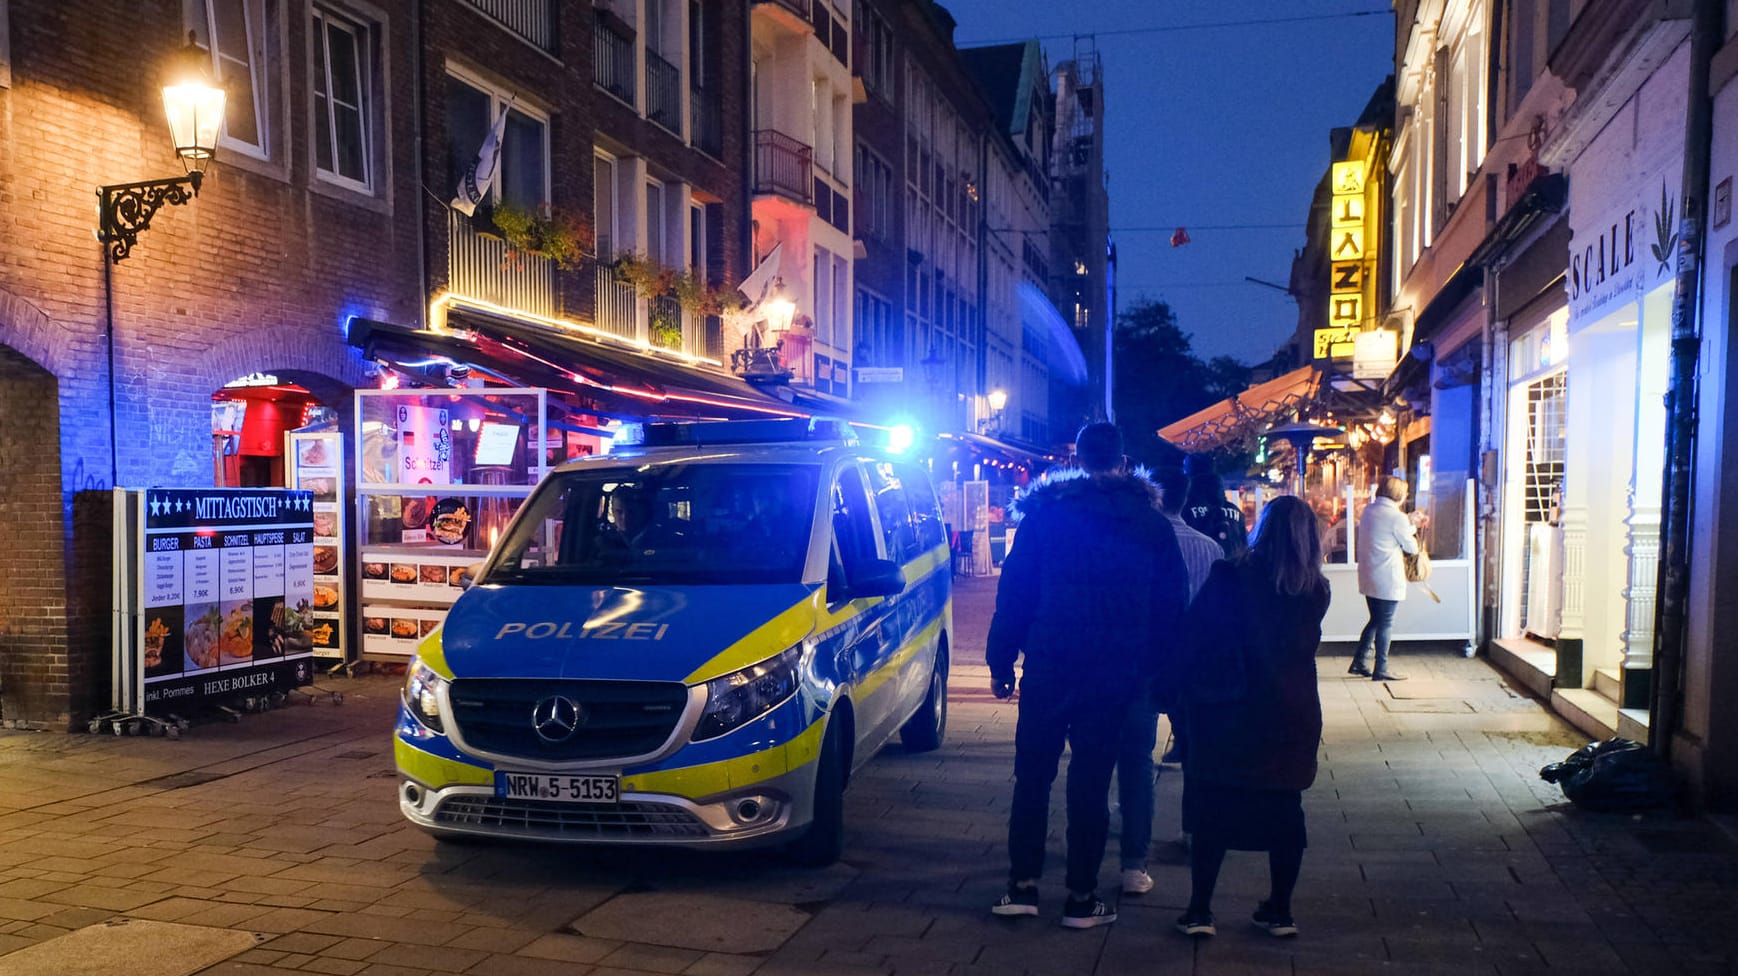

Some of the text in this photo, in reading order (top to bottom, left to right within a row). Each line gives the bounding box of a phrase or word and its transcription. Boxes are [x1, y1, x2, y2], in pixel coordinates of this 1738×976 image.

[1572, 209, 1635, 301] SCALE
[195, 496, 277, 519] MITTAGSTISCH
[153, 531, 306, 551] BURGER PASTA SCHNITZEL HAUPTSPEISE SALAT
[494, 621, 670, 641] POLIZEI
[162, 685, 195, 699] Pommes
[204, 671, 275, 696] HEXE BOLKER 4
[506, 775, 616, 800] NRW 5-5153
